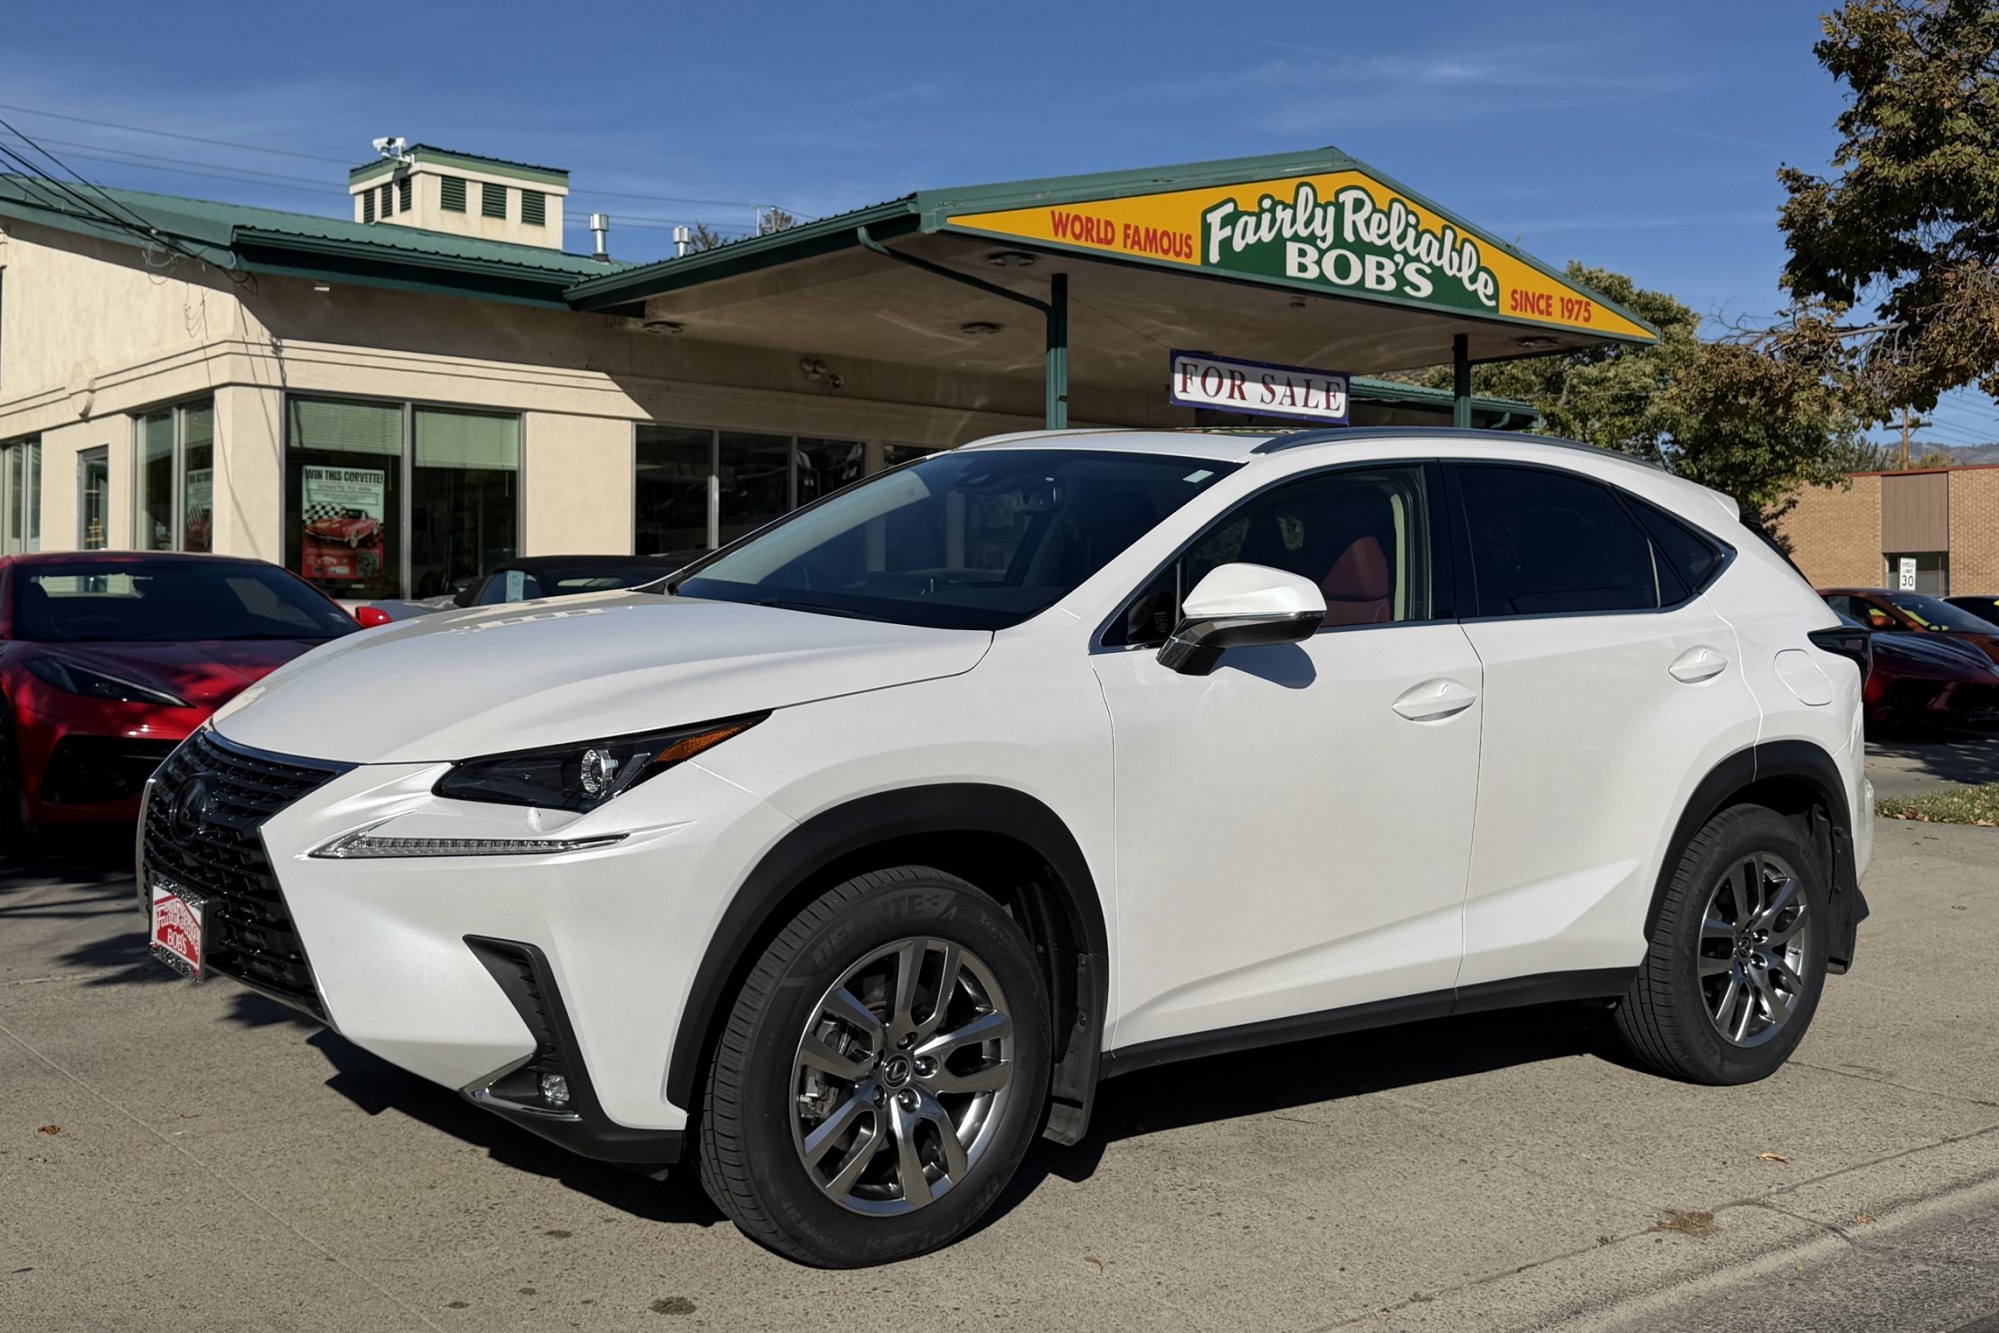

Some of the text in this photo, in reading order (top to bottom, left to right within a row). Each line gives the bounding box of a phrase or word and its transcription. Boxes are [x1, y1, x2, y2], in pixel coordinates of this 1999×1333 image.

[1051, 210, 1193, 259] WORLD FAMOUS
[1206, 186, 1497, 307] Fairly Reliable
[1286, 241, 1433, 298] BOB'S
[1510, 288, 1592, 323] SINCE 1975
[1179, 362, 1341, 411] FOR SALE
[305, 469, 323, 480] WIN
[325, 470, 343, 480] THIS
[1901, 575, 1914, 587] 30
